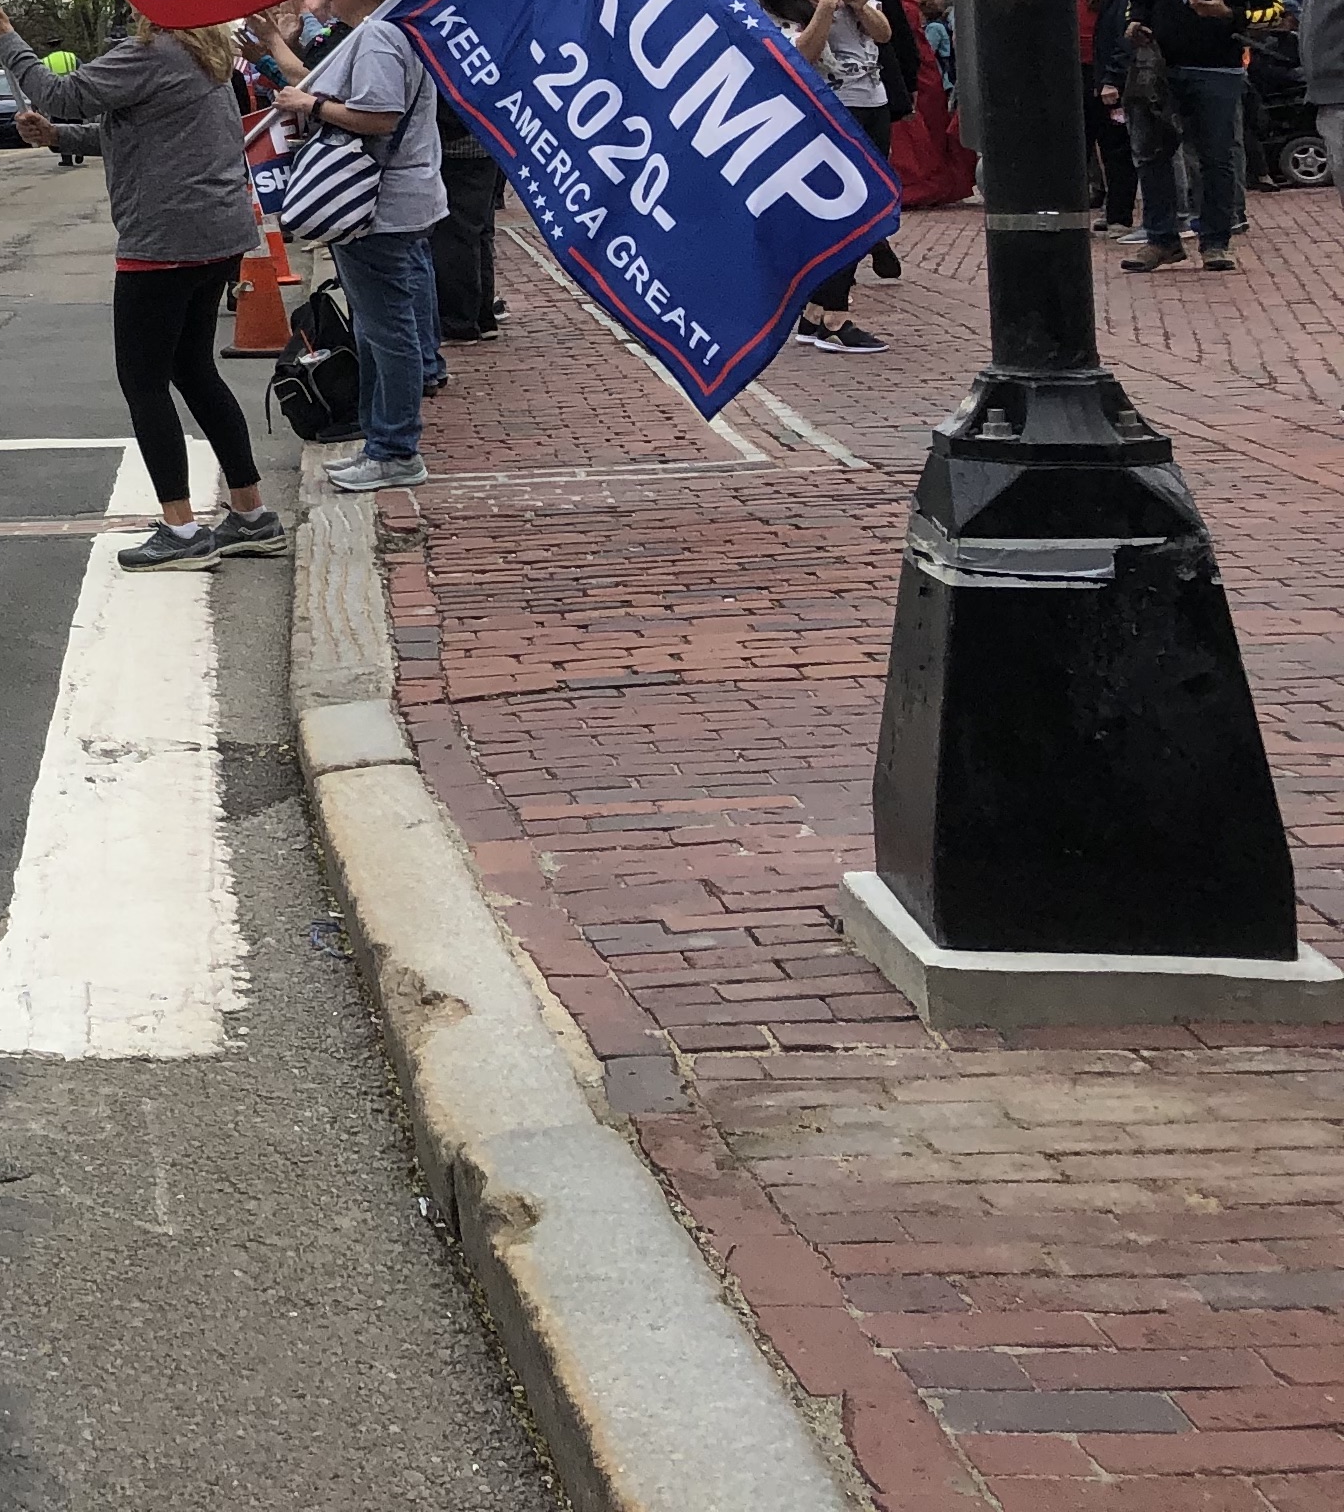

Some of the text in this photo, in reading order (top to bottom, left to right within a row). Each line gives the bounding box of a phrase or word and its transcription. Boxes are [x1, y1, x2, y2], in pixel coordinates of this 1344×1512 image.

[429, 4, 723, 366] KEEP AMERICA GREAT!
[529, 39, 677, 232] -2020-
